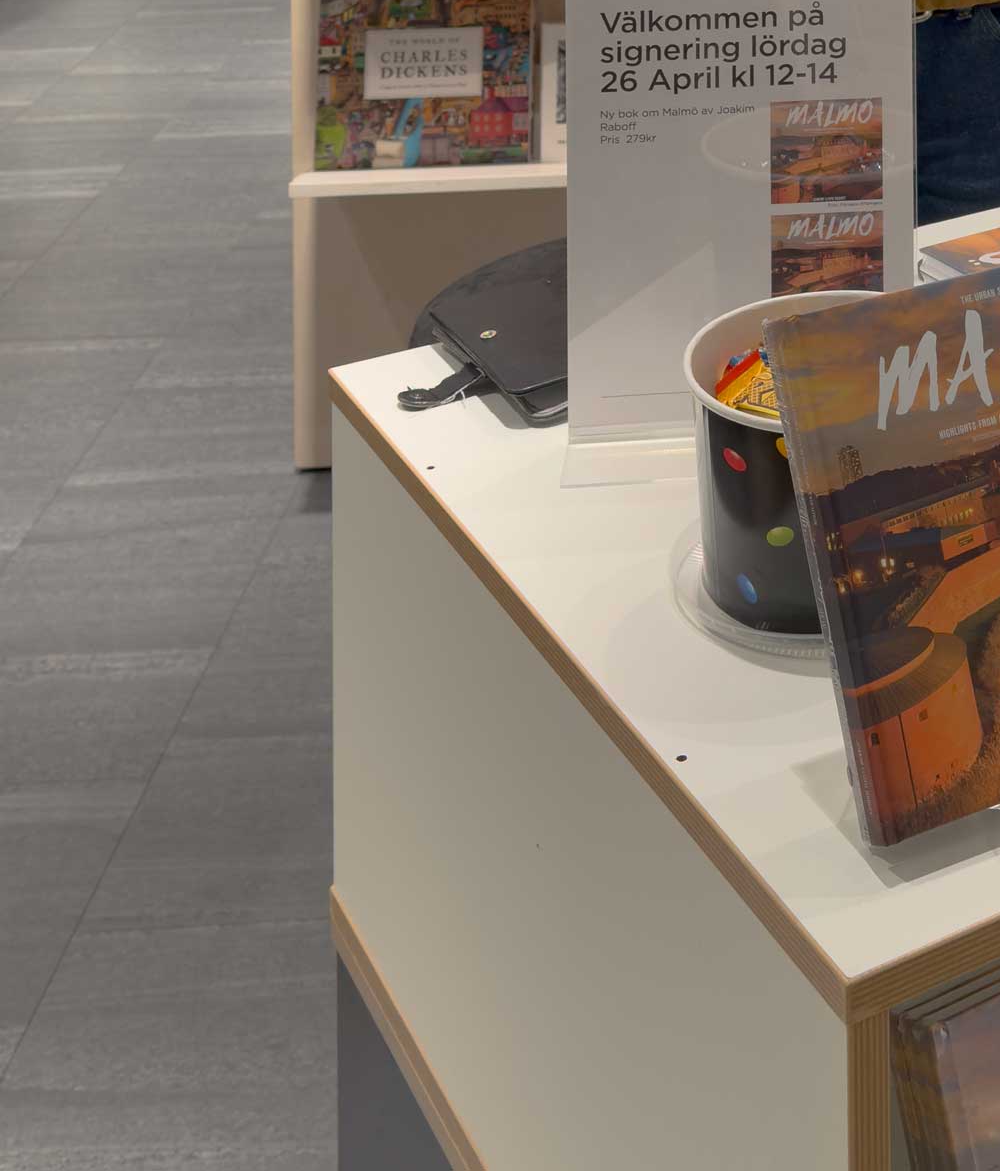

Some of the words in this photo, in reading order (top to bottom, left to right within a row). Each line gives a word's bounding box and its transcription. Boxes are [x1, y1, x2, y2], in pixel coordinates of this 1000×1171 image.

[600, 9, 777, 34] Välkommen
[788, 1, 824, 31] på
[380, 49, 467, 64] CHARLES
[600, 35, 740, 67] signering
[751, 34, 847, 59] lördag
[381, 65, 467, 79] DICKENS
[600, 70, 638, 93] 26
[648, 66, 720, 95] April
[731, 65, 755, 88] kl
[765, 62, 838, 86] 12-14
[600, 110, 614, 120] Ny
[618, 109, 639, 119] bok
[642, 110, 659, 118] om
[662, 107, 698, 117] Malmö
[701, 107, 714, 116] av
[717, 105, 755, 115] Joakim
[786, 98, 874, 128] MALMÖ
[600, 122, 637, 132] Raboff
[600, 135, 620, 145] Pris
[626, 134, 656, 144] 279kr
[786, 210, 874, 240] MALMÖ
[960, 294, 973, 305] THE
[974, 288, 996, 302] URBAN
[938, 421, 977, 440] HIGHLIGHTS
[978, 416, 998, 429] FROM
